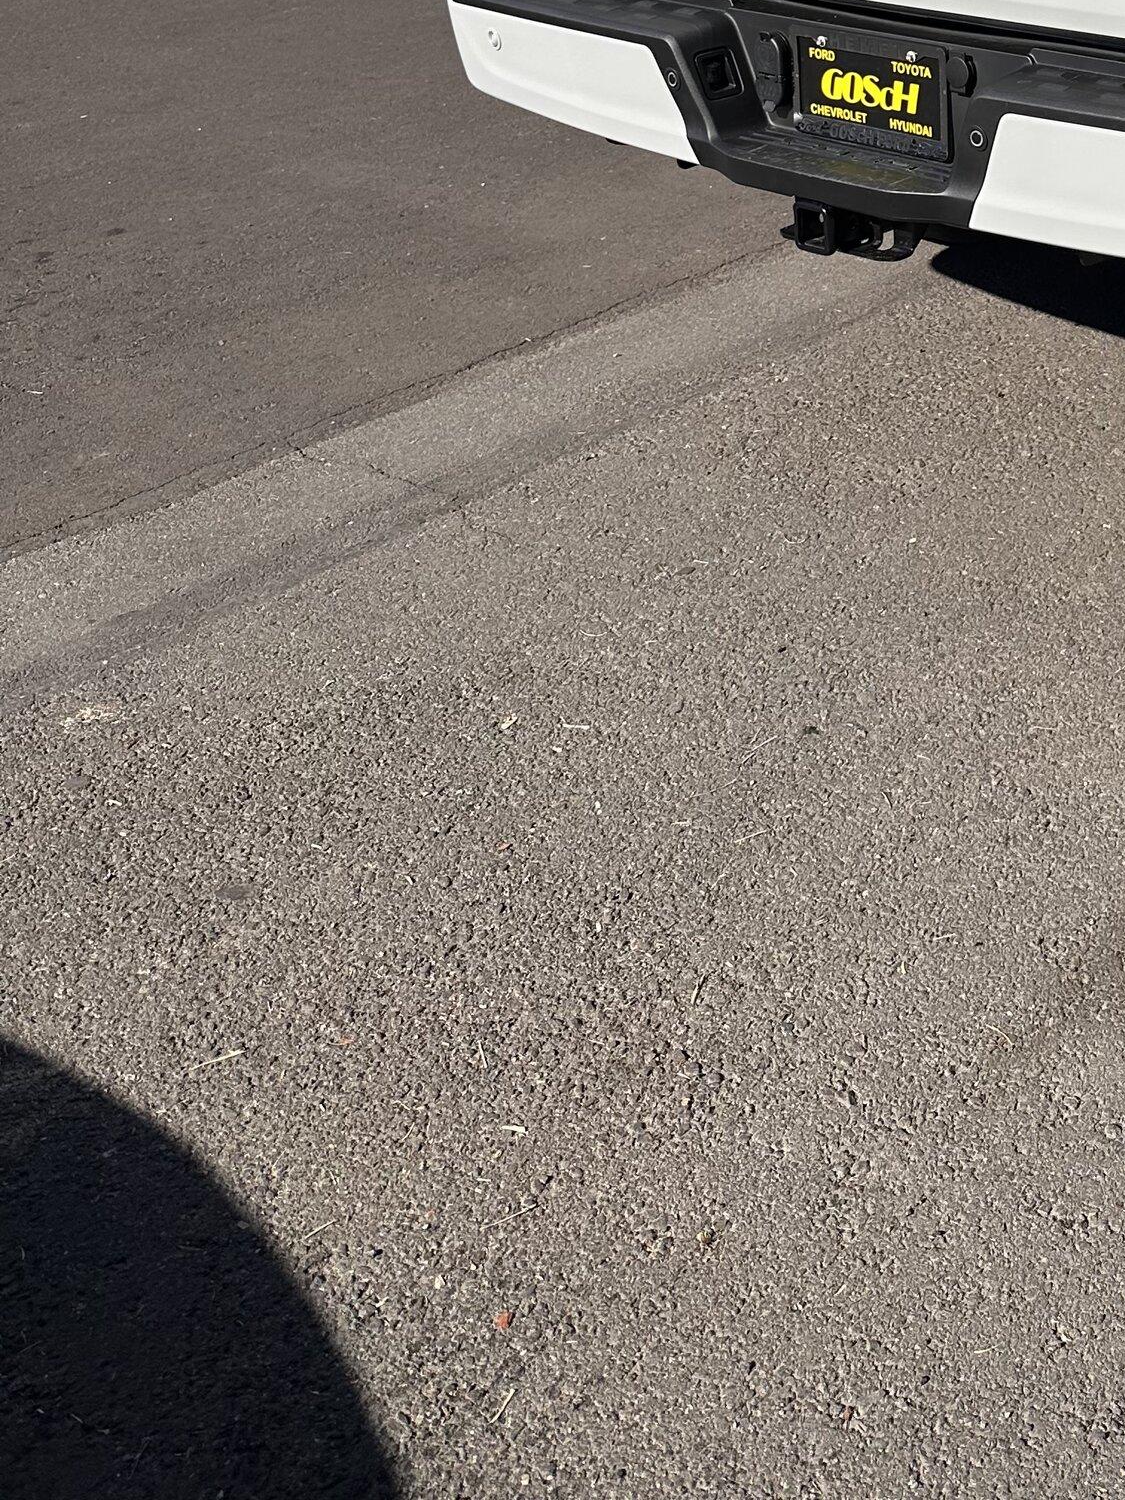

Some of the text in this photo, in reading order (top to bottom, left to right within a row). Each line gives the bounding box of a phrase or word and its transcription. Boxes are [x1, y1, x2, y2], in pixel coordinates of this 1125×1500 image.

[808, 47, 836, 62] FORD
[890, 61, 932, 79] TOYOTA
[810, 103, 868, 124] CHEVROLET
[889, 118, 933, 138] HYUNDAI
